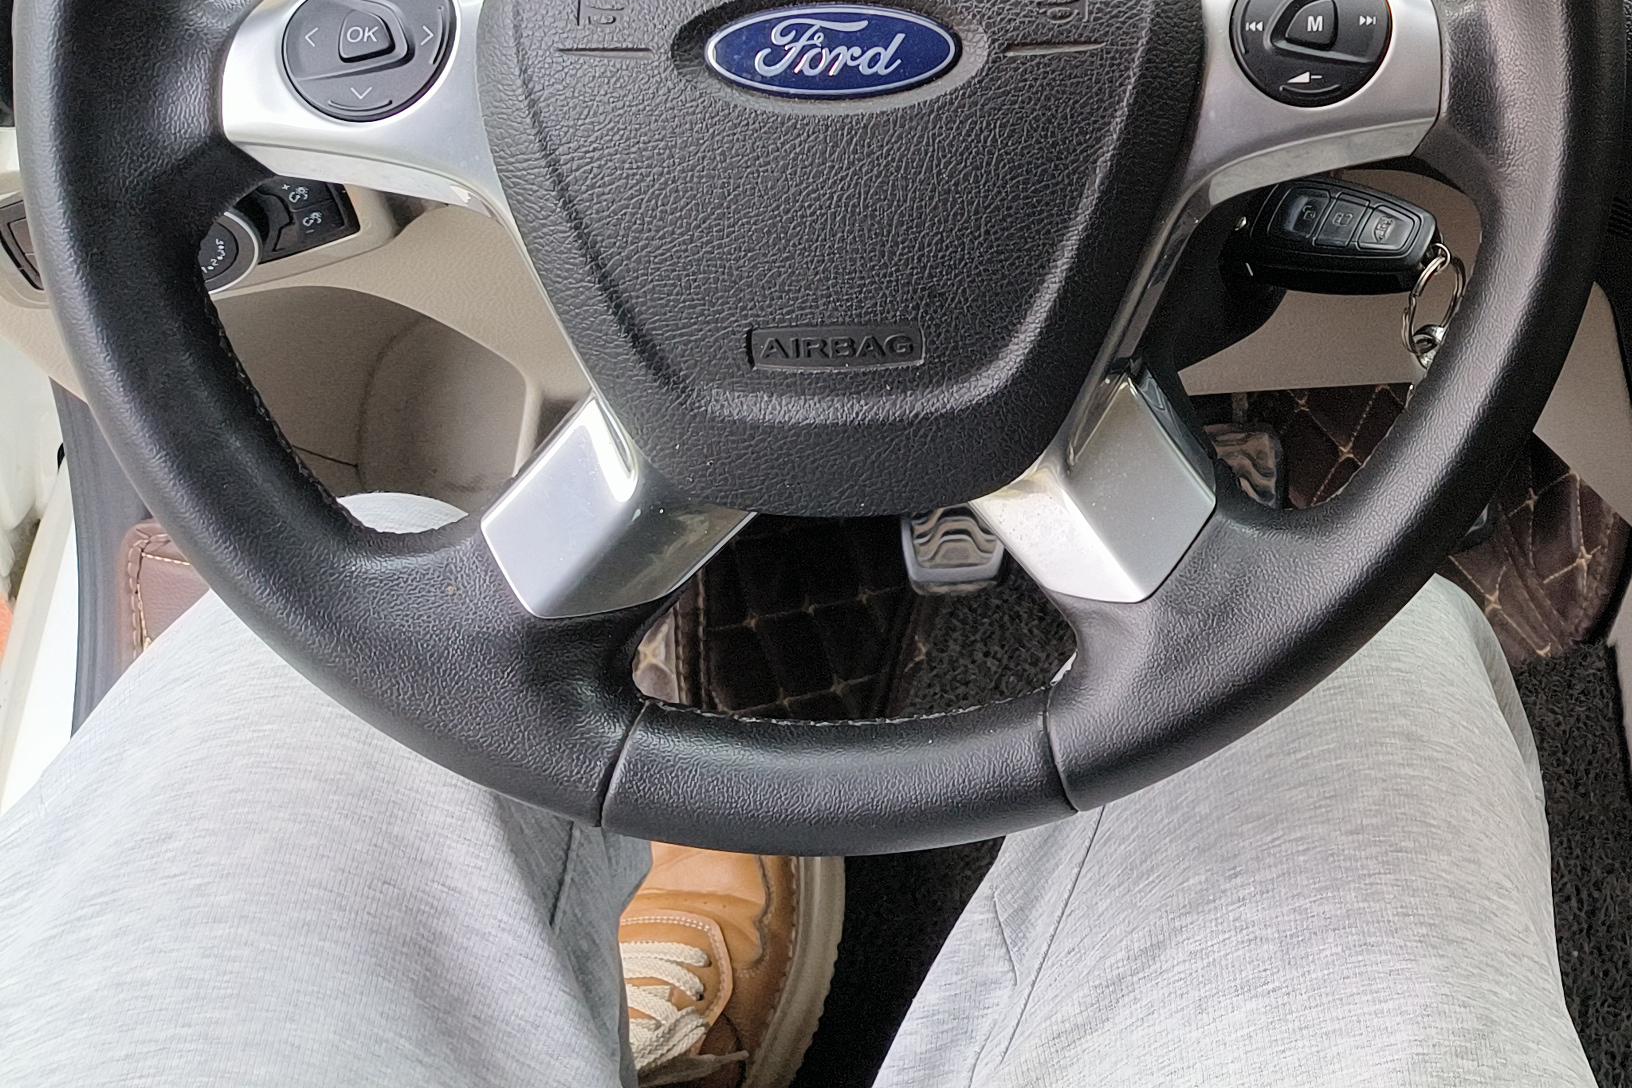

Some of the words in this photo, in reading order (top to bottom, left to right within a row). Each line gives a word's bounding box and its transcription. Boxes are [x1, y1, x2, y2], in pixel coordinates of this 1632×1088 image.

[347, 26, 379, 43] OK
[1307, 16, 1323, 32] M
[754, 18, 906, 77] Ford
[759, 333, 914, 359] AIRBAG
